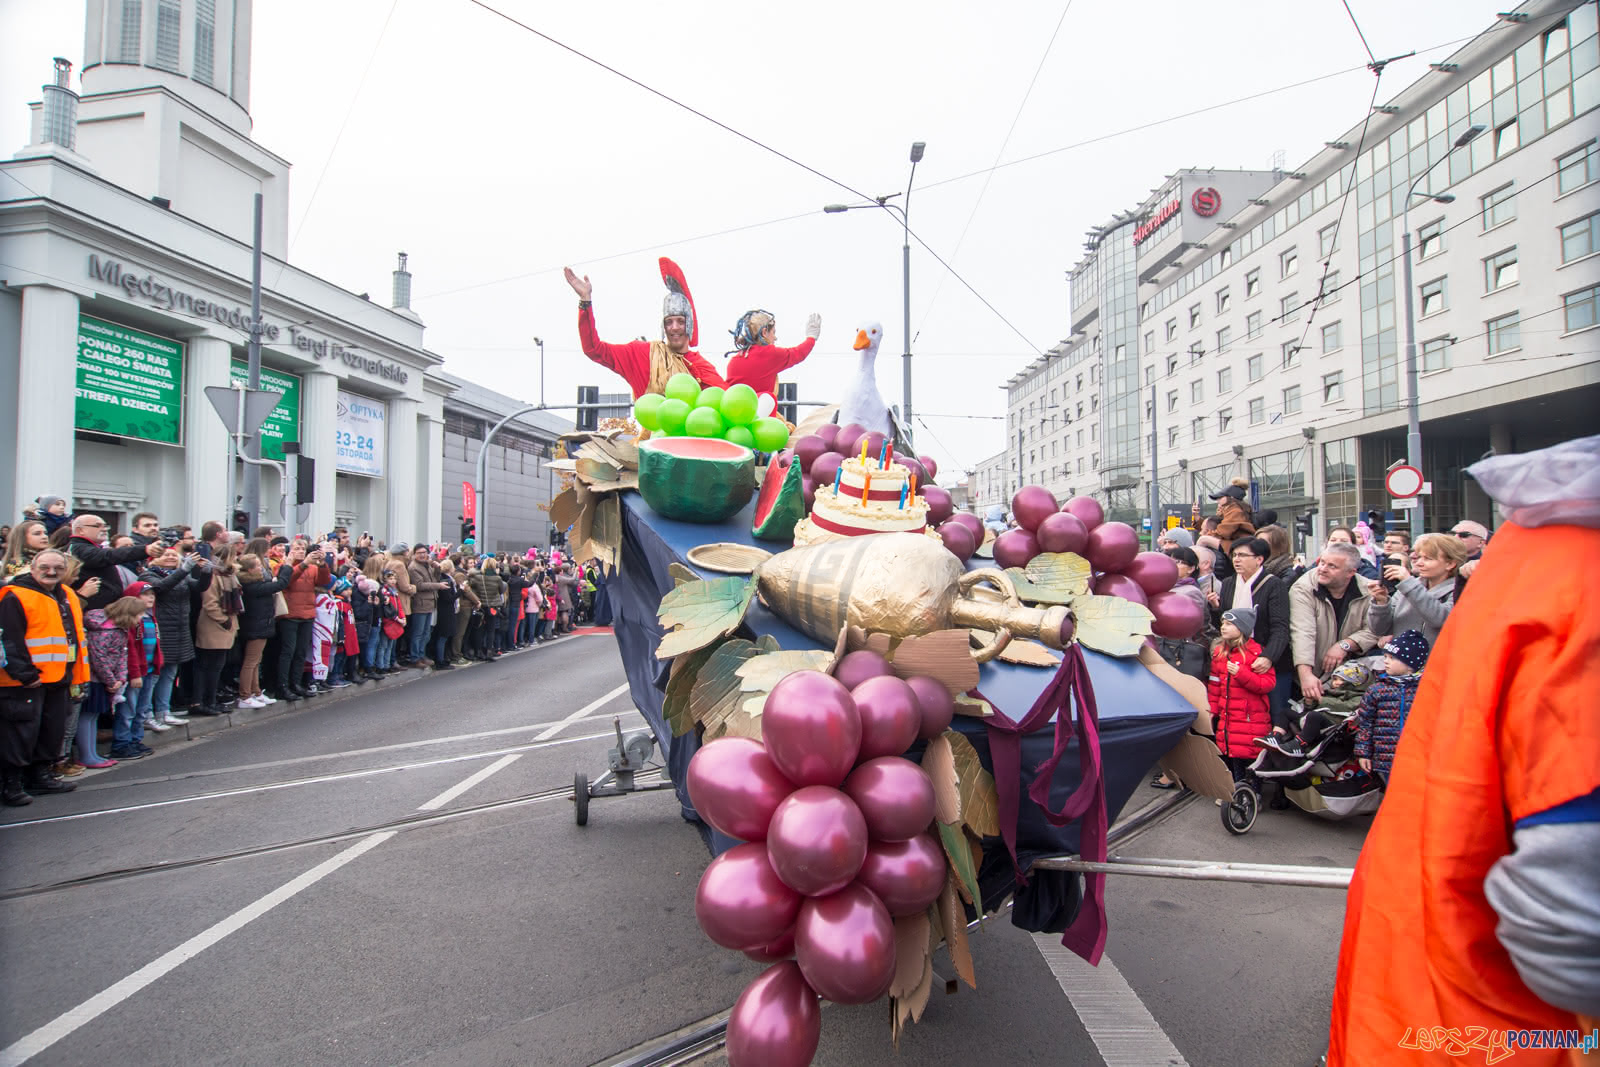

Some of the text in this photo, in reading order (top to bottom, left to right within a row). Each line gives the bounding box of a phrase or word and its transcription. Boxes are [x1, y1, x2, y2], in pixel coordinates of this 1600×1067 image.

[79, 335, 121, 354] PONAD
[123, 347, 145, 361] 260
[147, 353, 169, 367] RAS
[288, 326, 328, 360] Targi
[331, 343, 408, 384] Poznańskie
[76, 361, 102, 373] ONAD
[132, 360, 172, 379] ŚWIATA
[74, 387, 168, 415] STREFA DZIECKA
[349, 402, 384, 421] OPTYKA
[336, 430, 374, 452] 23-24
[336, 447, 374, 461] ISTOPADA
